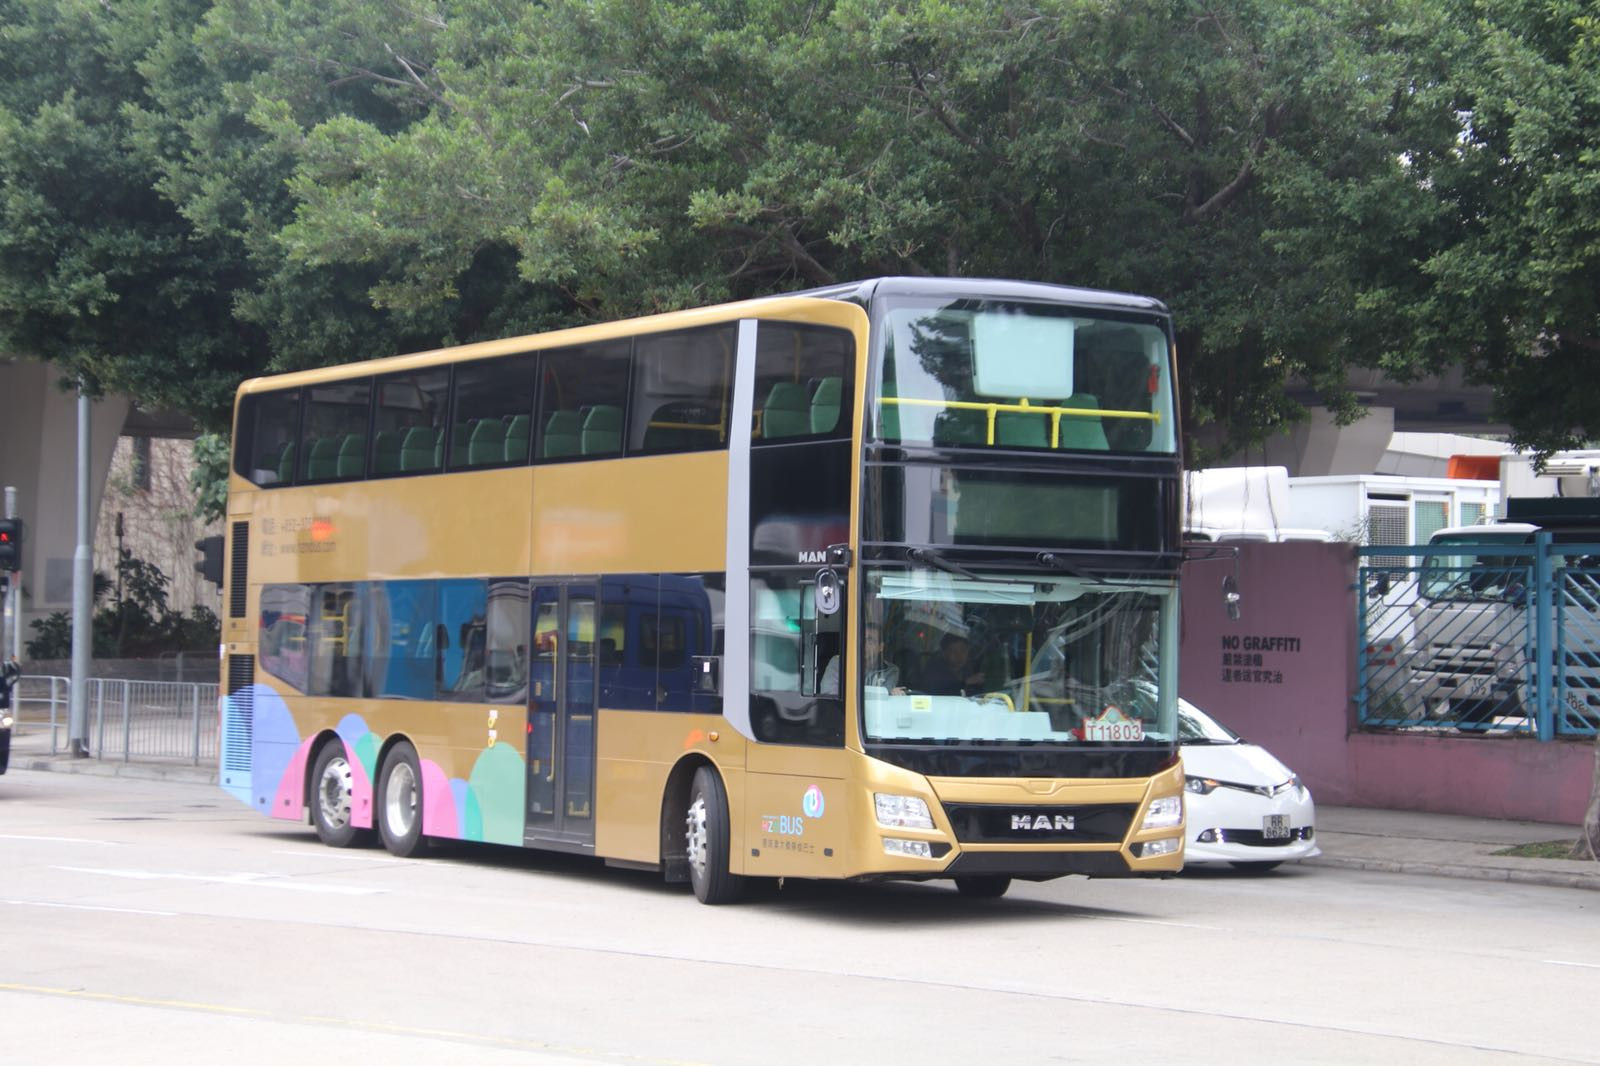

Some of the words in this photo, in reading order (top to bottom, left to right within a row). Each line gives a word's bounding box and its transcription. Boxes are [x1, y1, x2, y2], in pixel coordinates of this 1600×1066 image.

[798, 551, 826, 563] MAN
[1222, 635, 1240, 650] NO
[1243, 635, 1301, 652] GRAFFITI
[779, 815, 804, 836] BUS
[1011, 814, 1075, 830] MAN
